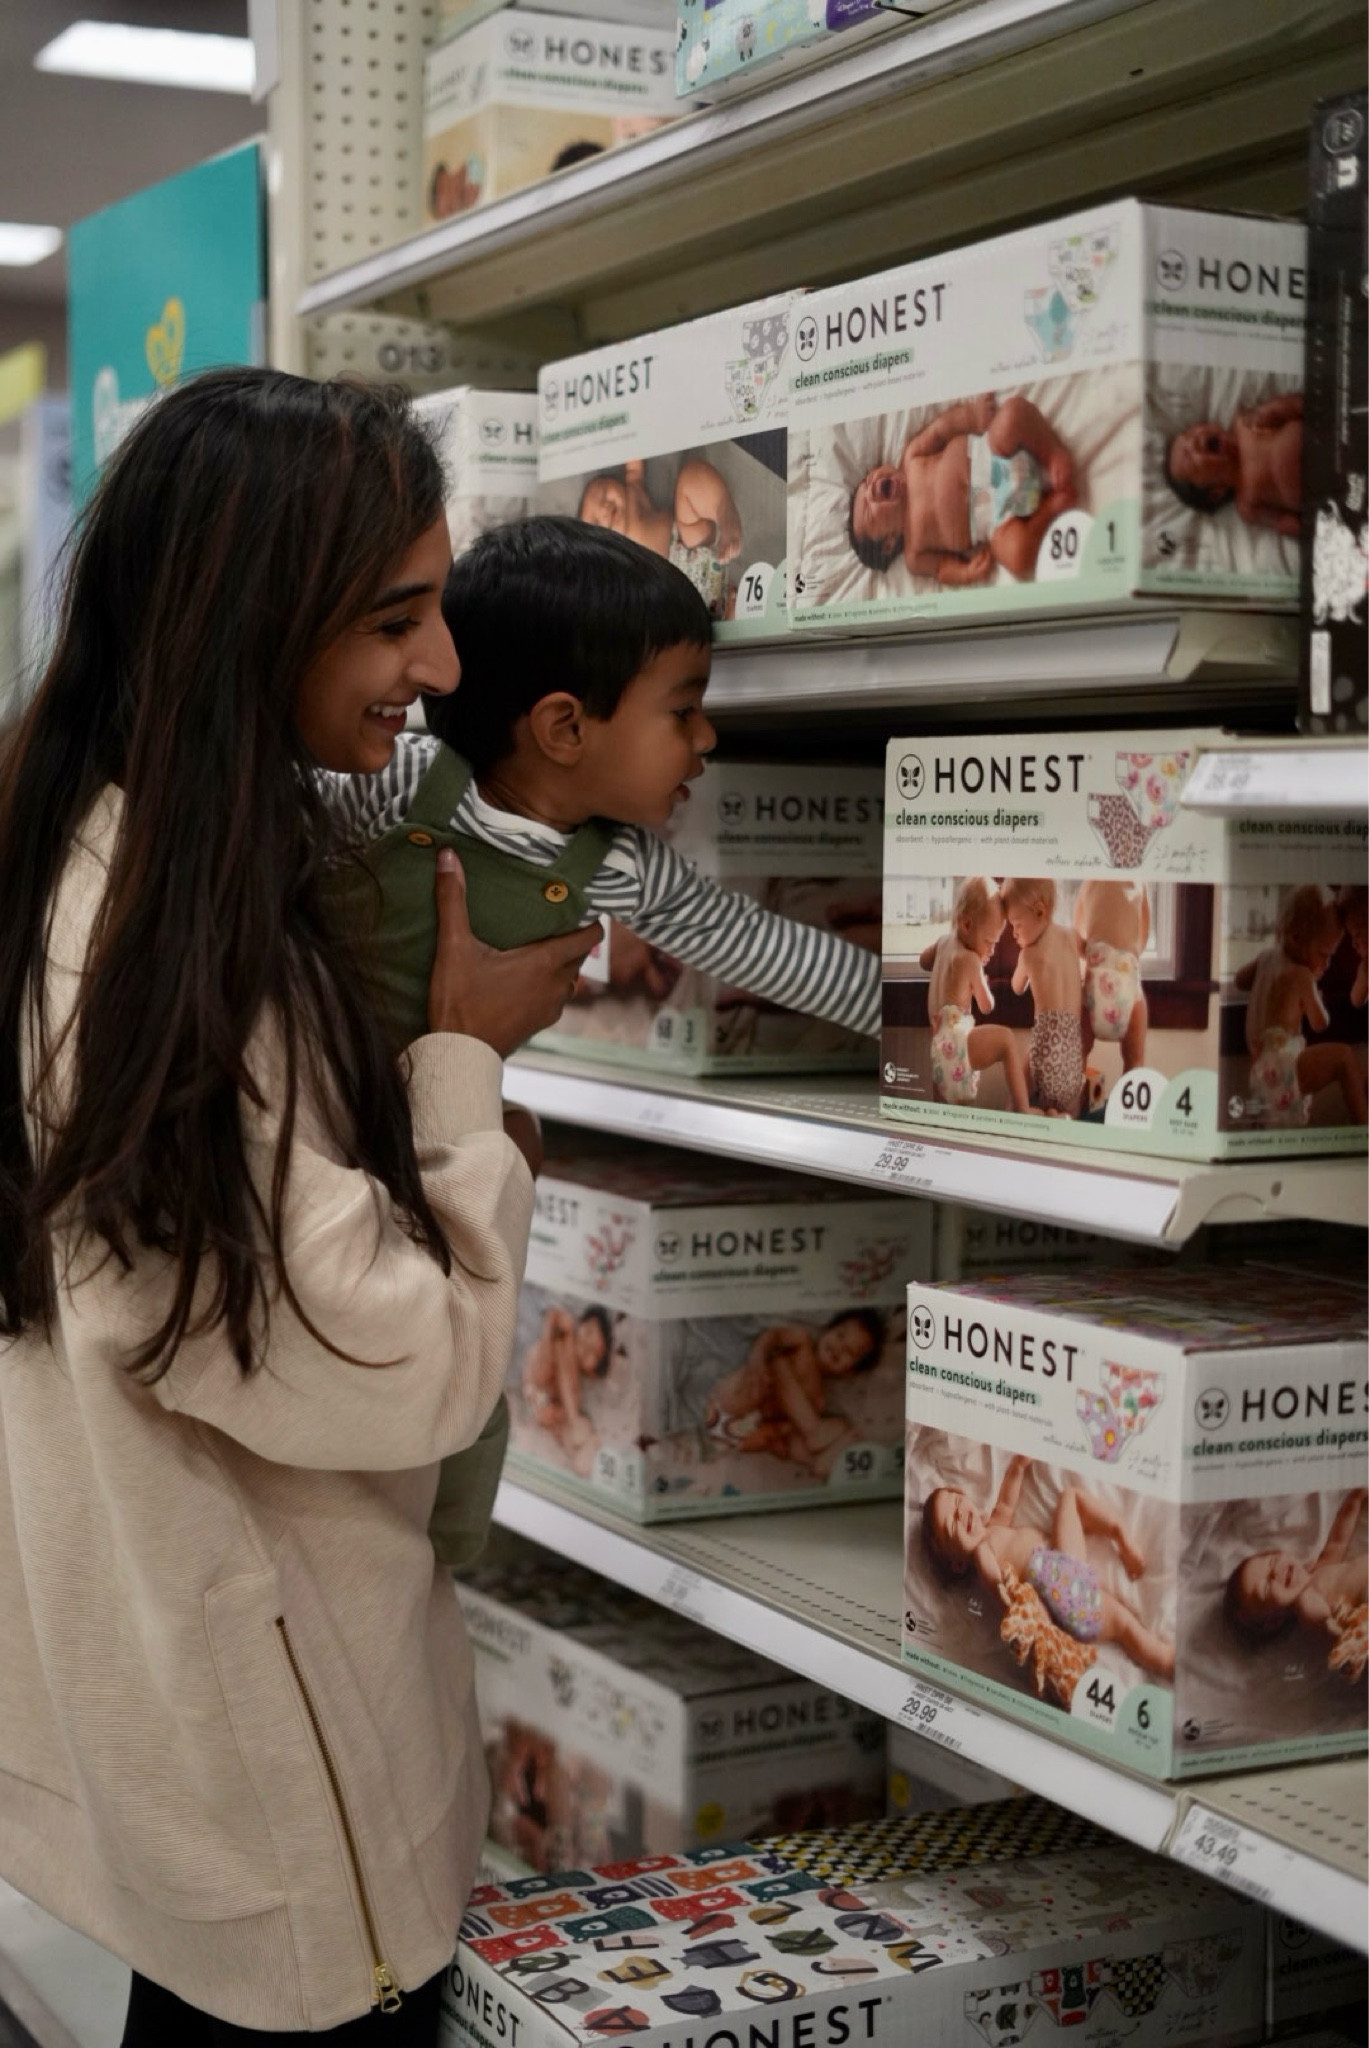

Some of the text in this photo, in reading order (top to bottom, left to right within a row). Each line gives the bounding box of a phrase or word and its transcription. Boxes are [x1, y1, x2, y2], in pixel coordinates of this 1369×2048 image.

[544, 36, 677, 77] HONES
[826, 283, 946, 350] HONEST
[563, 355, 654, 411] HONEST
[795, 351, 910, 389] clean conscious diapers
[1051, 526, 1078, 560] 80
[1107, 520, 1117, 551] 1
[745, 574, 764, 603] 76
[934, 753, 1085, 794] HONEST
[896, 808, 1039, 833] clean conscious diapers
[1239, 818, 1273, 834] clean
[1278, 816, 1341, 835] conscious
[1121, 1080, 1152, 1111] 60
[1175, 1086, 1193, 1117] 4
[874, 1152, 909, 1172] 29.99
[691, 1226, 826, 1258] HONEST
[943, 1314, 1078, 1383] HONEST
[909, 1356, 1037, 1405] clean conscious diapers
[1241, 1380, 1368, 1422] HONE
[1192, 1438, 1233, 1457] clean
[1238, 1432, 1312, 1452] conscious
[845, 1450, 873, 1473] 50
[902, 1696, 937, 1723] 29.99
[1086, 1677, 1116, 1714] 44
[1137, 1698, 1150, 1730] 6
[1194, 1833, 1239, 1867] 43.49
[593, 1935, 660, 1953] F
[602, 1957, 671, 1985] E
[530, 1976, 591, 2004] B
[583, 2004, 652, 2031] A
